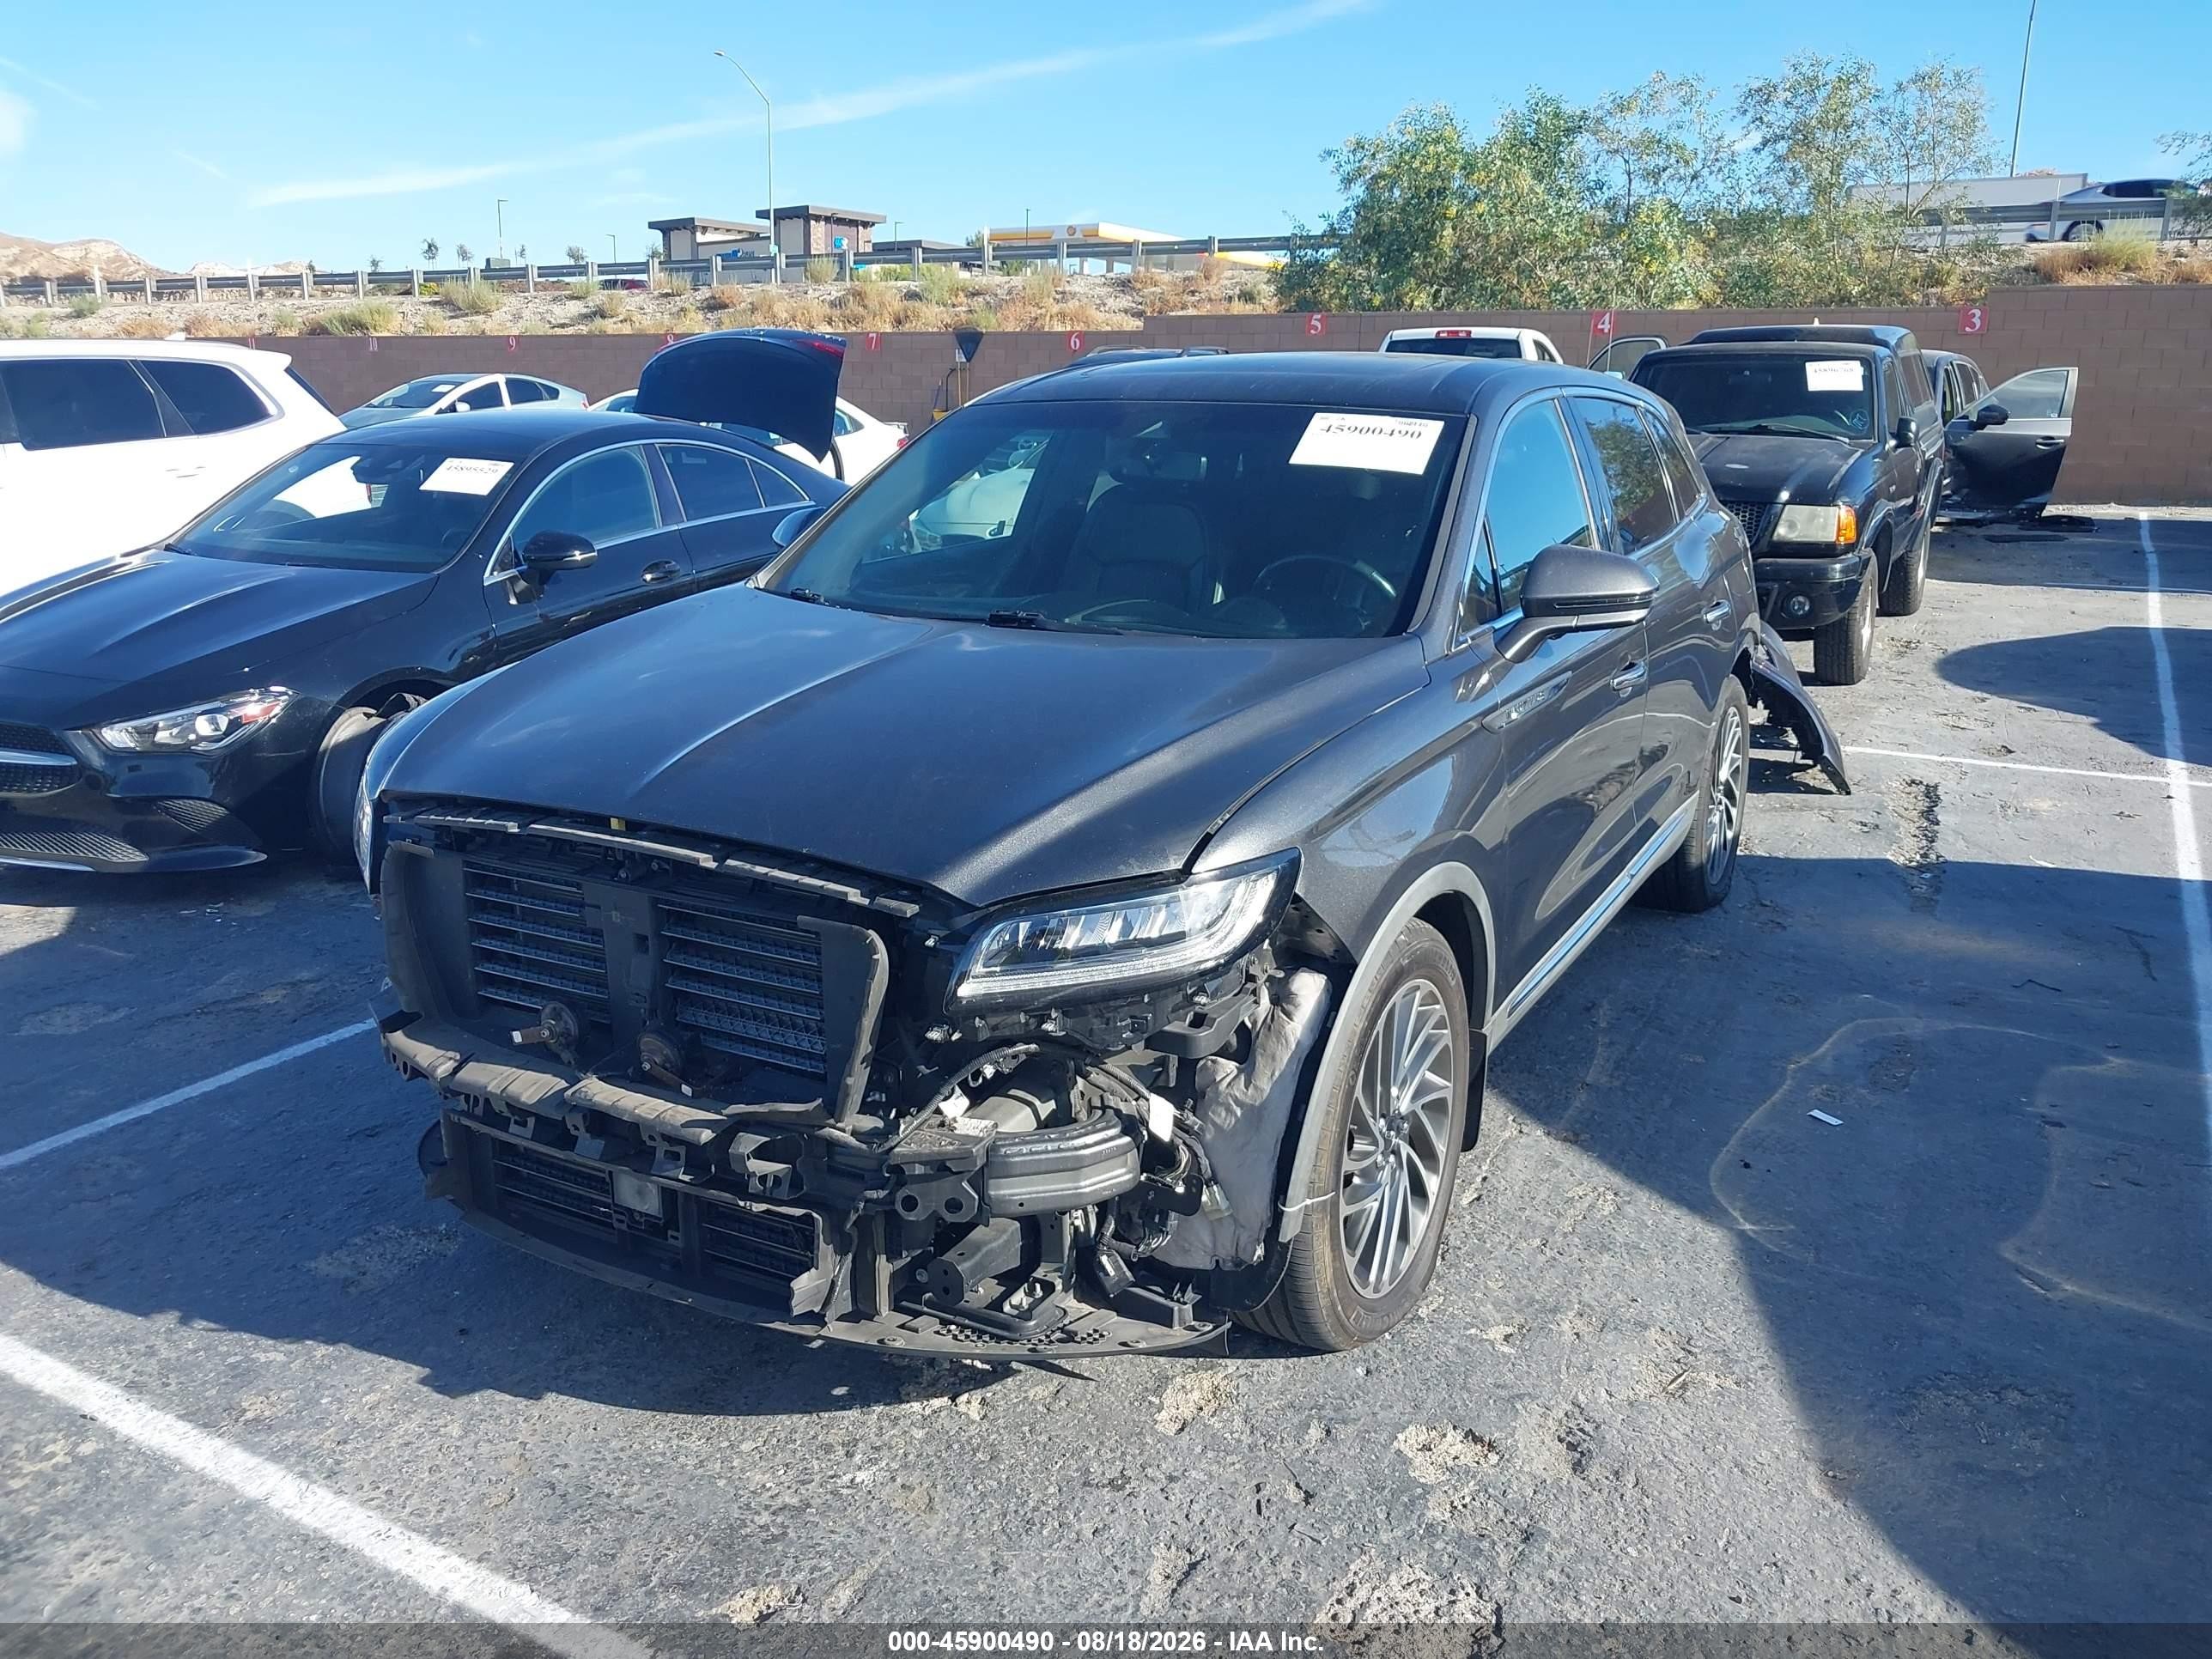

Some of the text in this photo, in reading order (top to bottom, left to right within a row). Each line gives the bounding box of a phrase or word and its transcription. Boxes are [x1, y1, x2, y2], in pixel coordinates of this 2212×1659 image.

[1310, 314, 1322, 334] 5
[1598, 313, 1611, 332] 4
[1965, 309, 1982, 331] 3
[369, 337, 378, 351] 10
[509, 337, 516, 350] 9
[869, 332, 877, 349] 7
[1071, 332, 1080, 350] 6
[1319, 424, 1422, 440] 45900490
